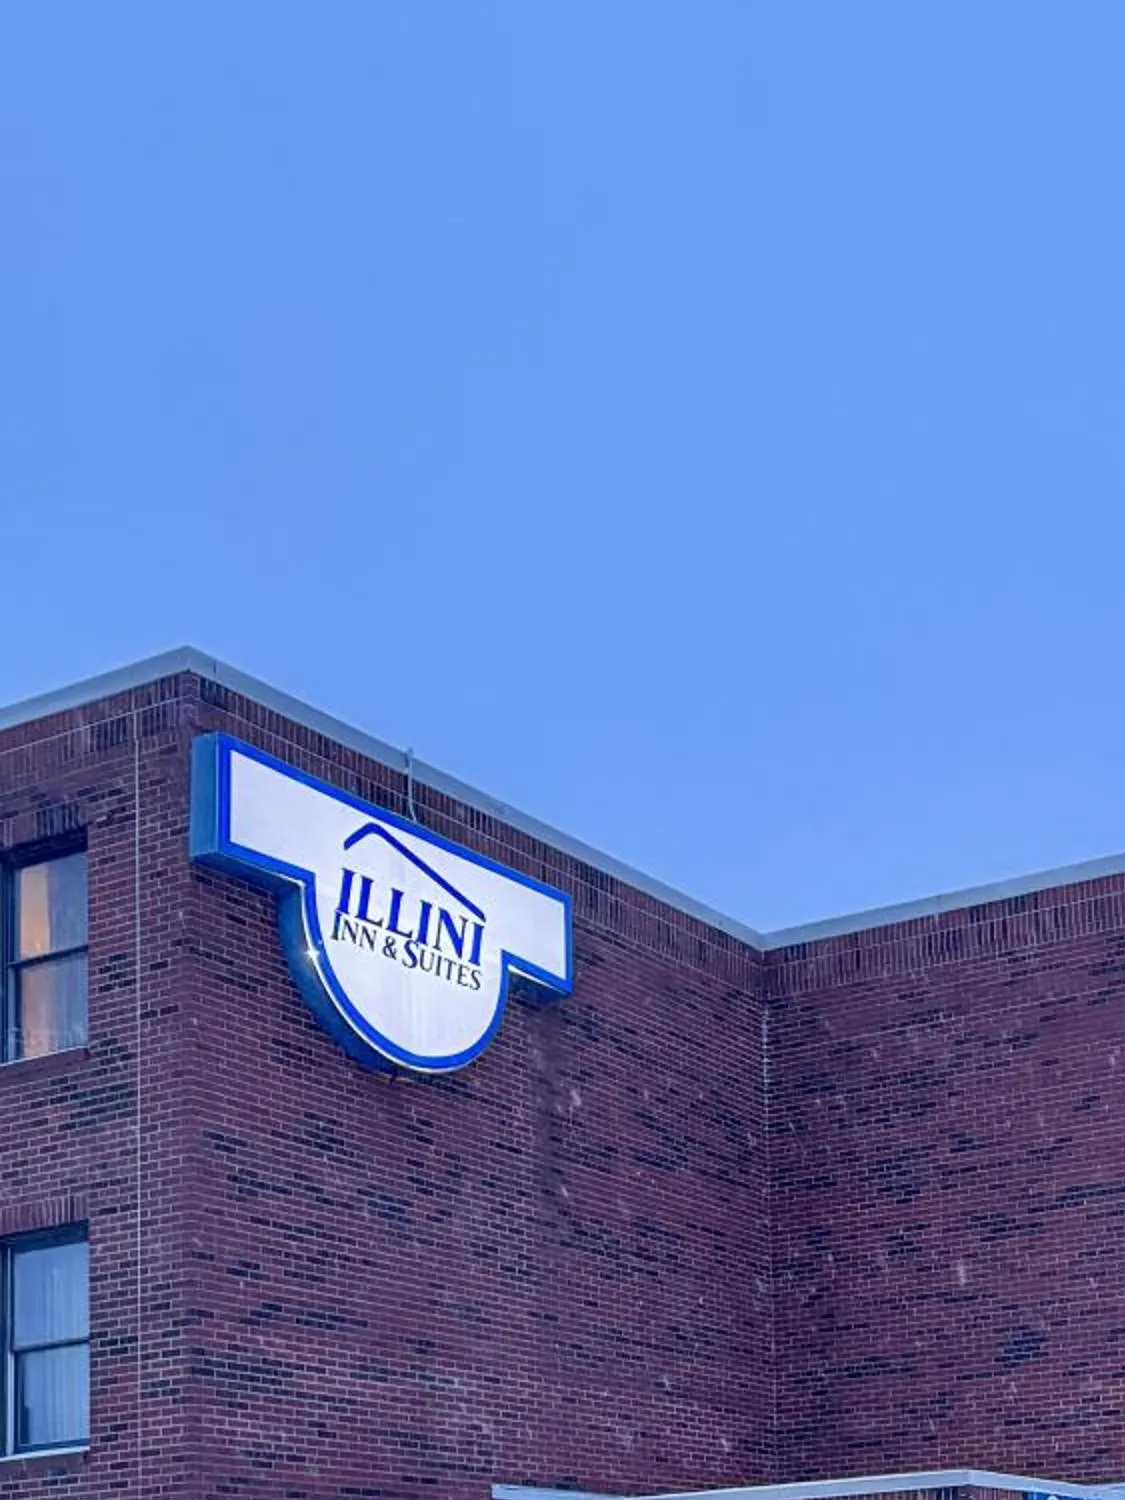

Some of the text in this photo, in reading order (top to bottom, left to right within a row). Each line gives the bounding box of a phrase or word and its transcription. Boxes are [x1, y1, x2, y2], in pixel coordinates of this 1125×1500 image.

[331, 912, 483, 991] INN & SUITES
[335, 867, 485, 966] ILLINI
